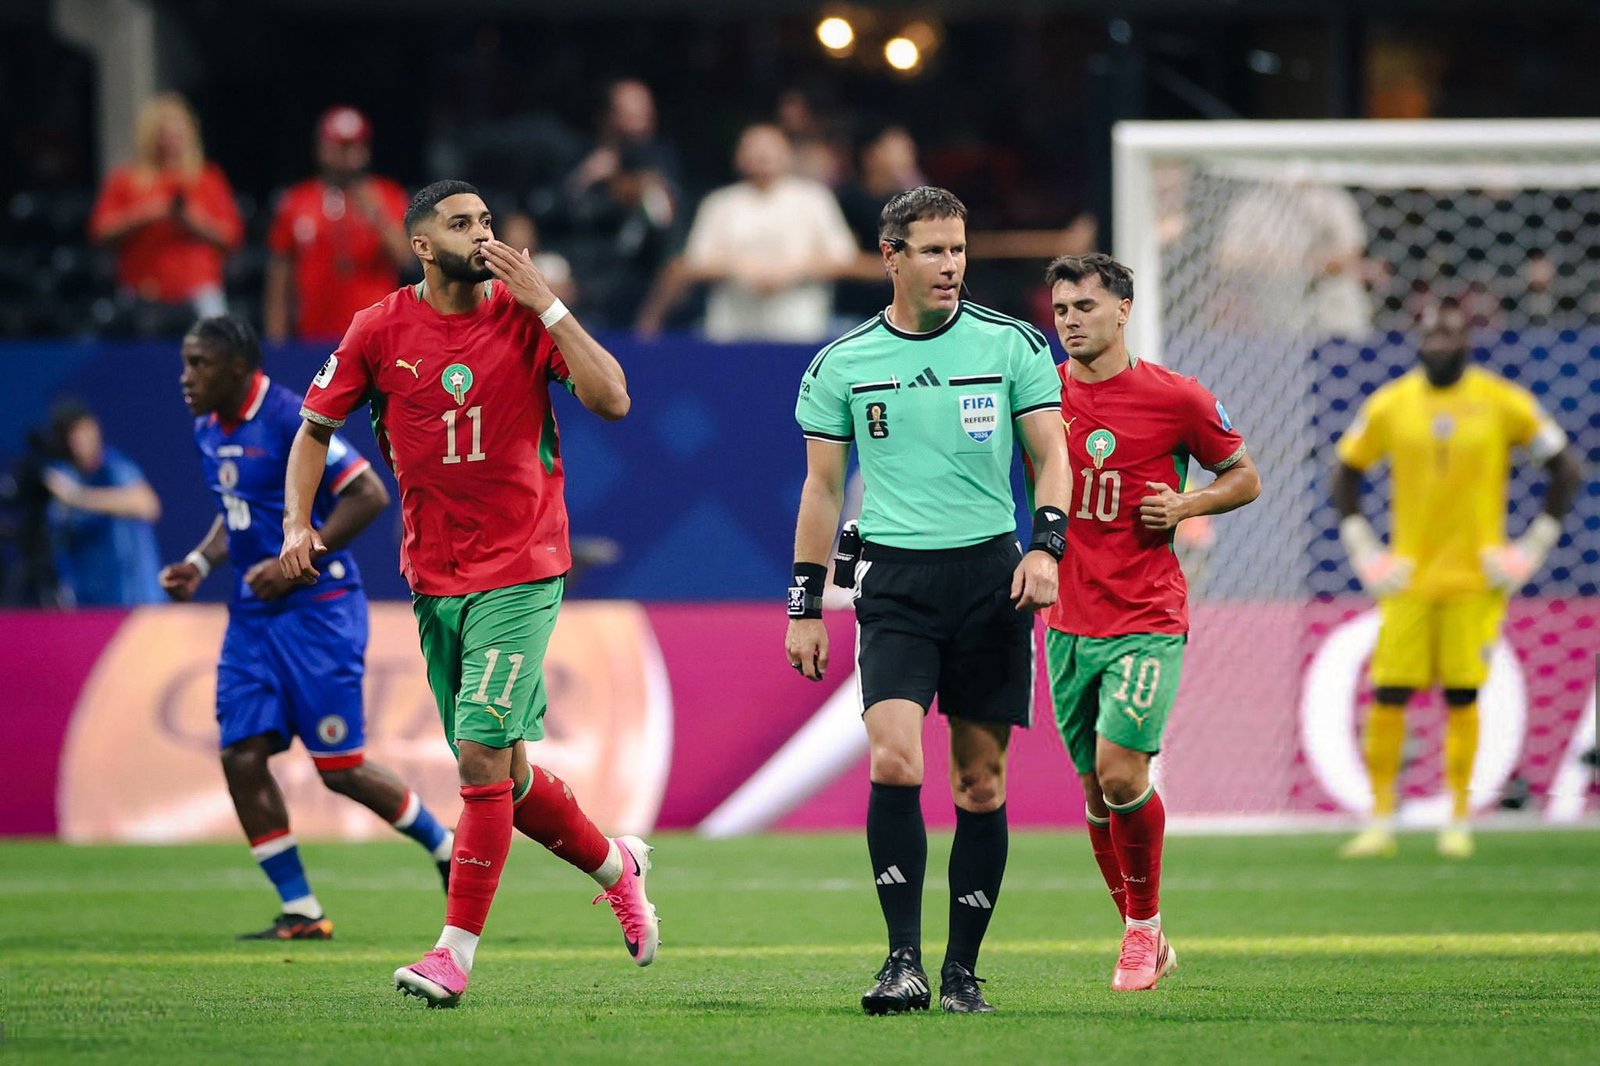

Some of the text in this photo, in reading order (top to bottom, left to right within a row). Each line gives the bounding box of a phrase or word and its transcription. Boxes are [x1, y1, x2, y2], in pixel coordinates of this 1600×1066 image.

[963, 397, 994, 410] FIFA
[964, 416, 996, 424] REFEREE
[441, 405, 486, 465] 11
[1076, 467, 1122, 522] 10
[471, 648, 525, 709] 11
[1113, 654, 1160, 708] 10
